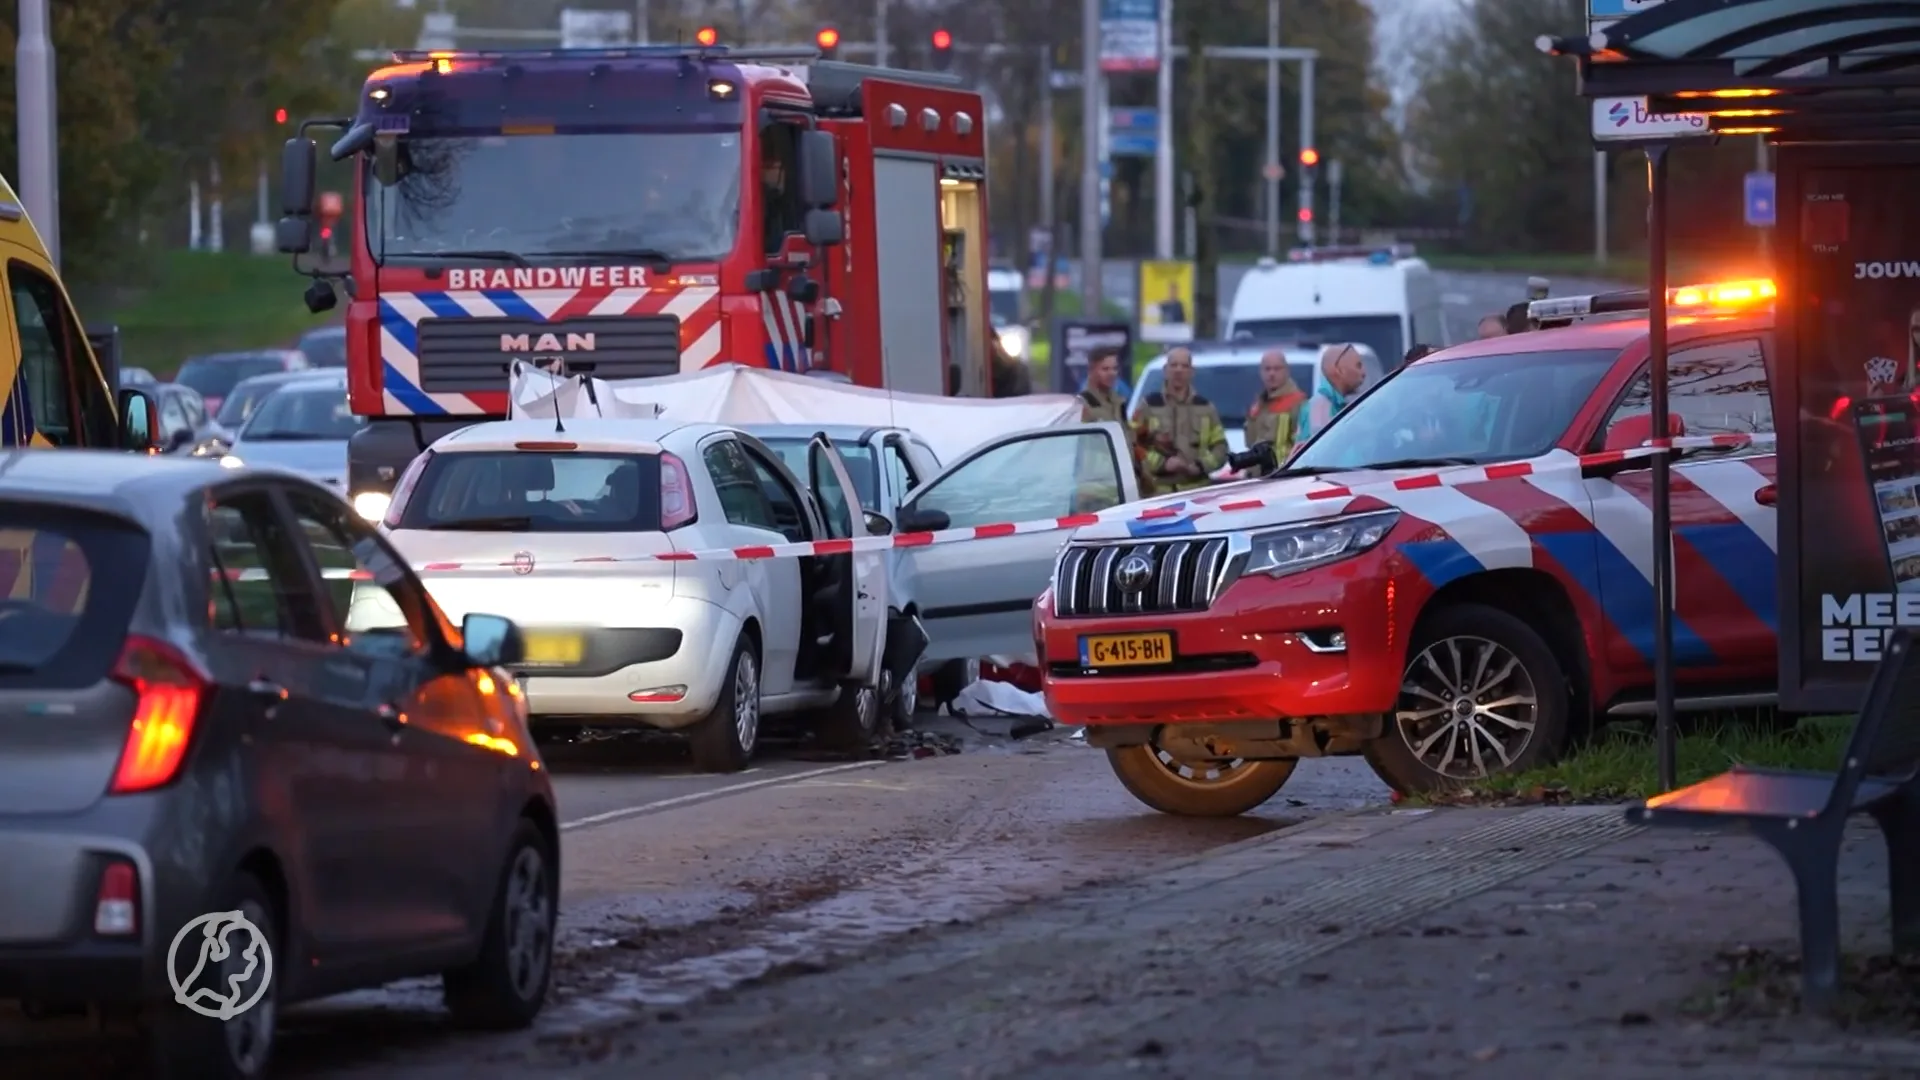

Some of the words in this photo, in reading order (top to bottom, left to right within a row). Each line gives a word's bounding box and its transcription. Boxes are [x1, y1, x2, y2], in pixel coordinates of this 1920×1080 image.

[448, 266, 647, 289] BRANDWEER
[500, 332, 595, 352] MAN
[1094, 639, 1164, 662] G-415-BH
